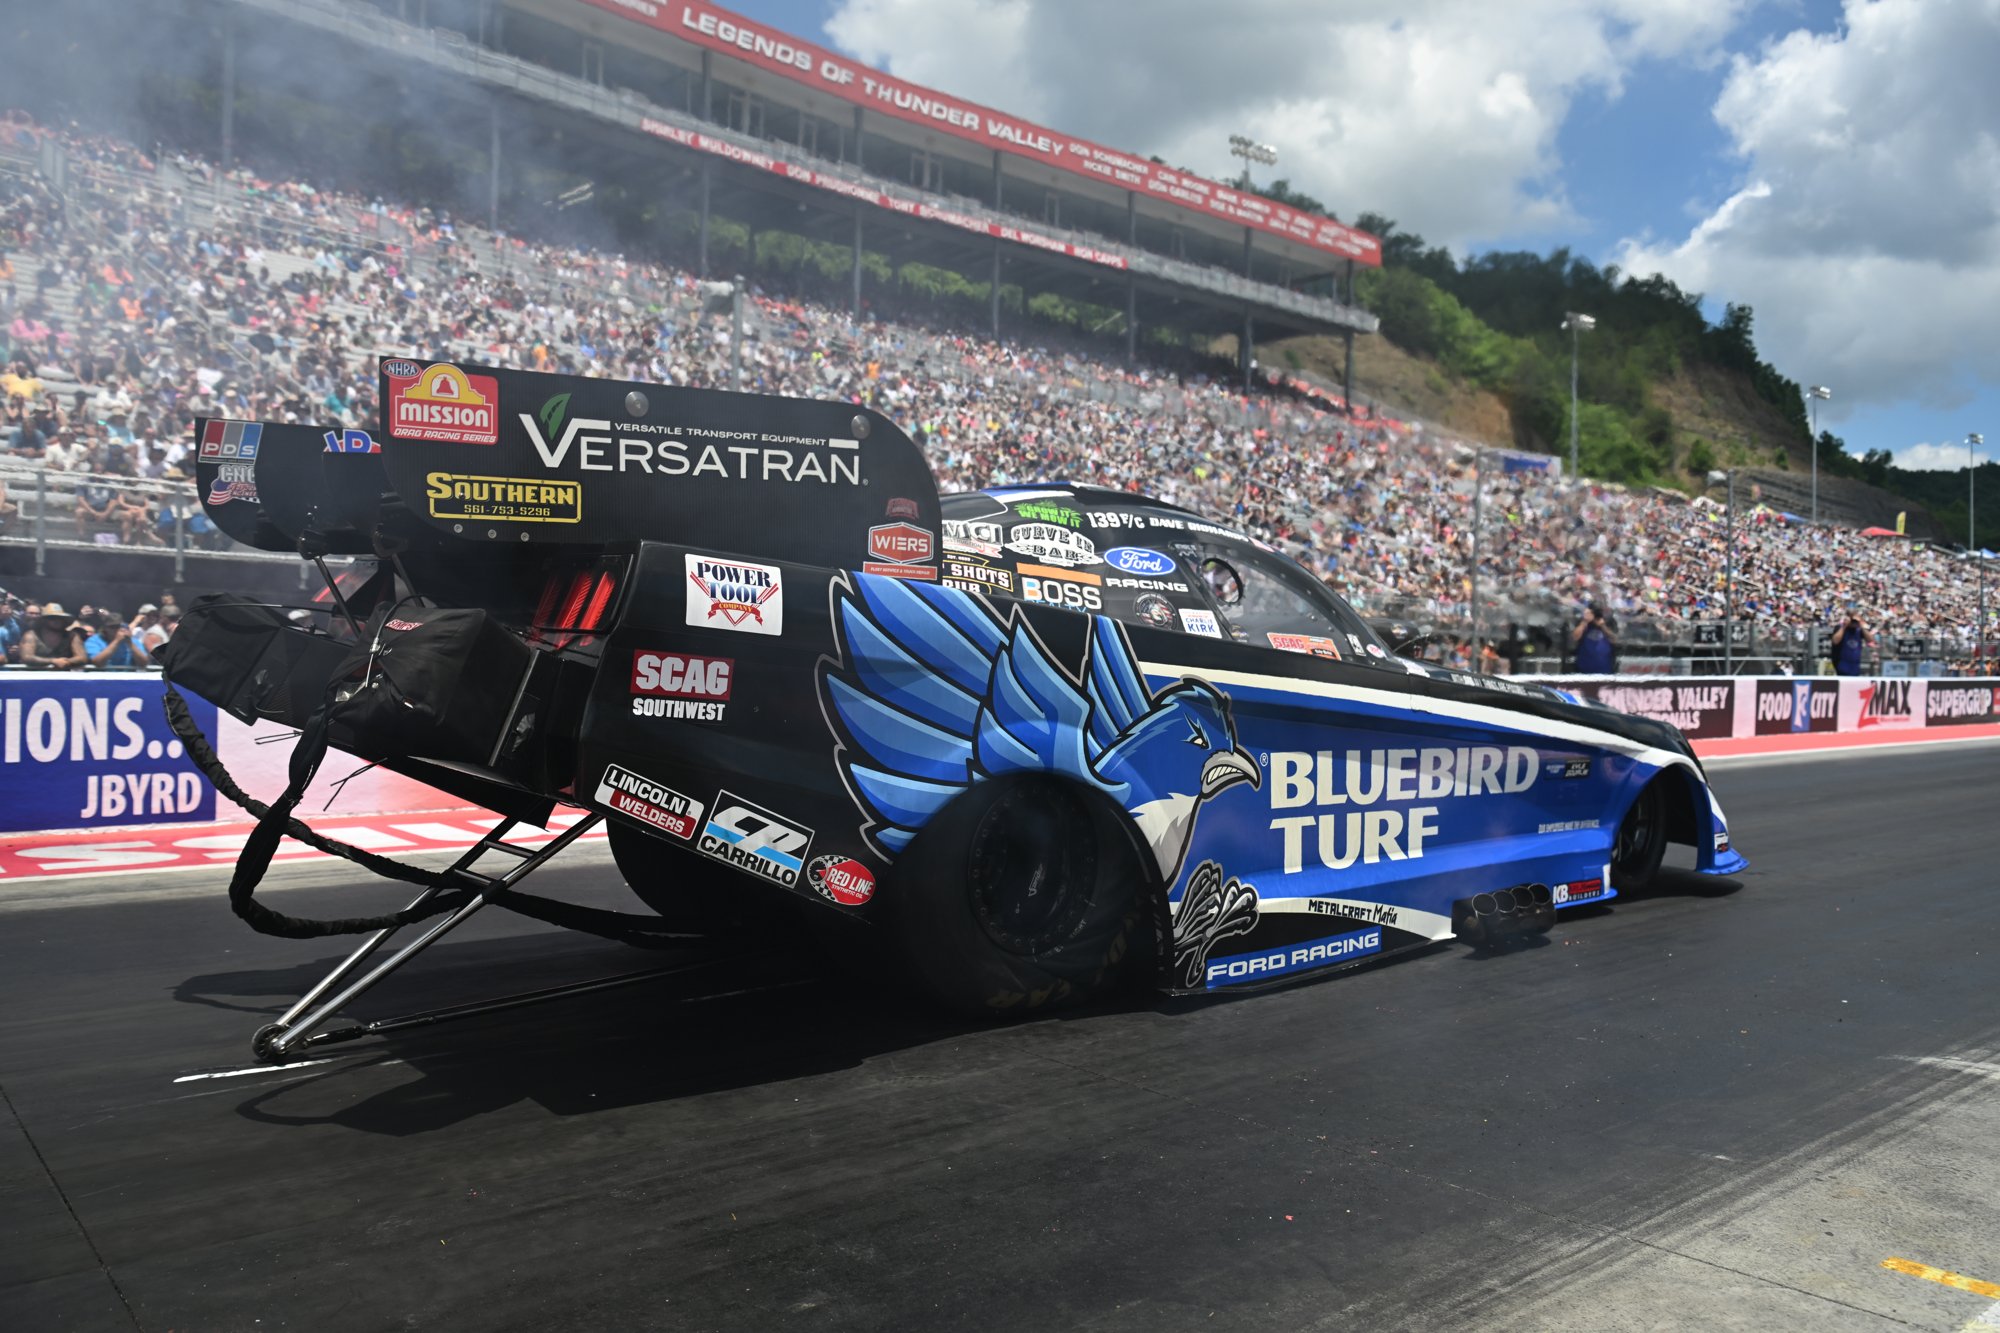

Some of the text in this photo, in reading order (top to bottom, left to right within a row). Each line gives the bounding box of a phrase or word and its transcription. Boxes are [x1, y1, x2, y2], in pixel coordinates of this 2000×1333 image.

[682, 6, 1063, 156] LEGENDS OF THUNDER VALLEY
[387, 362, 416, 376] NHRA
[400, 402, 489, 428] MISSION
[393, 427, 497, 443] DRAG RACING SERIES
[615, 422, 827, 446] VERSATILE TRANSPORT EQUIPMENT
[204, 442, 255, 456] PDS
[518, 412, 860, 486] VERSATRAN
[426, 472, 575, 505] SOUTHERN
[463, 504, 551, 516] 561-753-5296
[1086, 512, 1121, 528] 139
[1149, 517, 1185, 530] DAVE
[874, 535, 929, 553] WIERS
[1013, 525, 1093, 553] CURVE IN
[1032, 545, 1080, 562] BAR
[1119, 550, 1163, 571] Ford
[696, 561, 772, 588] POWER
[951, 563, 1010, 588] SHOTS
[1105, 577, 1189, 593] RACING
[706, 581, 763, 605] TOOL
[1021, 577, 1102, 610] BOSS
[718, 601, 753, 613] COMPANY
[1187, 623, 1216, 633] KIRK
[635, 653, 730, 696] SCAG
[632, 697, 725, 721] SOUTHWEST
[1677, 686, 1729, 710] VALLEY
[1757, 691, 1793, 721] FOOD
[1810, 690, 1837, 719] CITY
[1927, 687, 1993, 718] SUPERGRIP
[1269, 745, 1540, 810] BLUEBIRD
[80, 771, 203, 819] JBYRD
[607, 769, 686, 815] LINCOLN
[619, 794, 685, 833] WELDERS
[1269, 806, 1440, 875] TURF
[700, 835, 797, 885] CARRILLO
[826, 868, 874, 896] RED LINE
[1552, 884, 1569, 904] KB
[1308, 899, 1398, 926] METALCRAFT Mafia
[1207, 932, 1379, 981] FORD RACING
